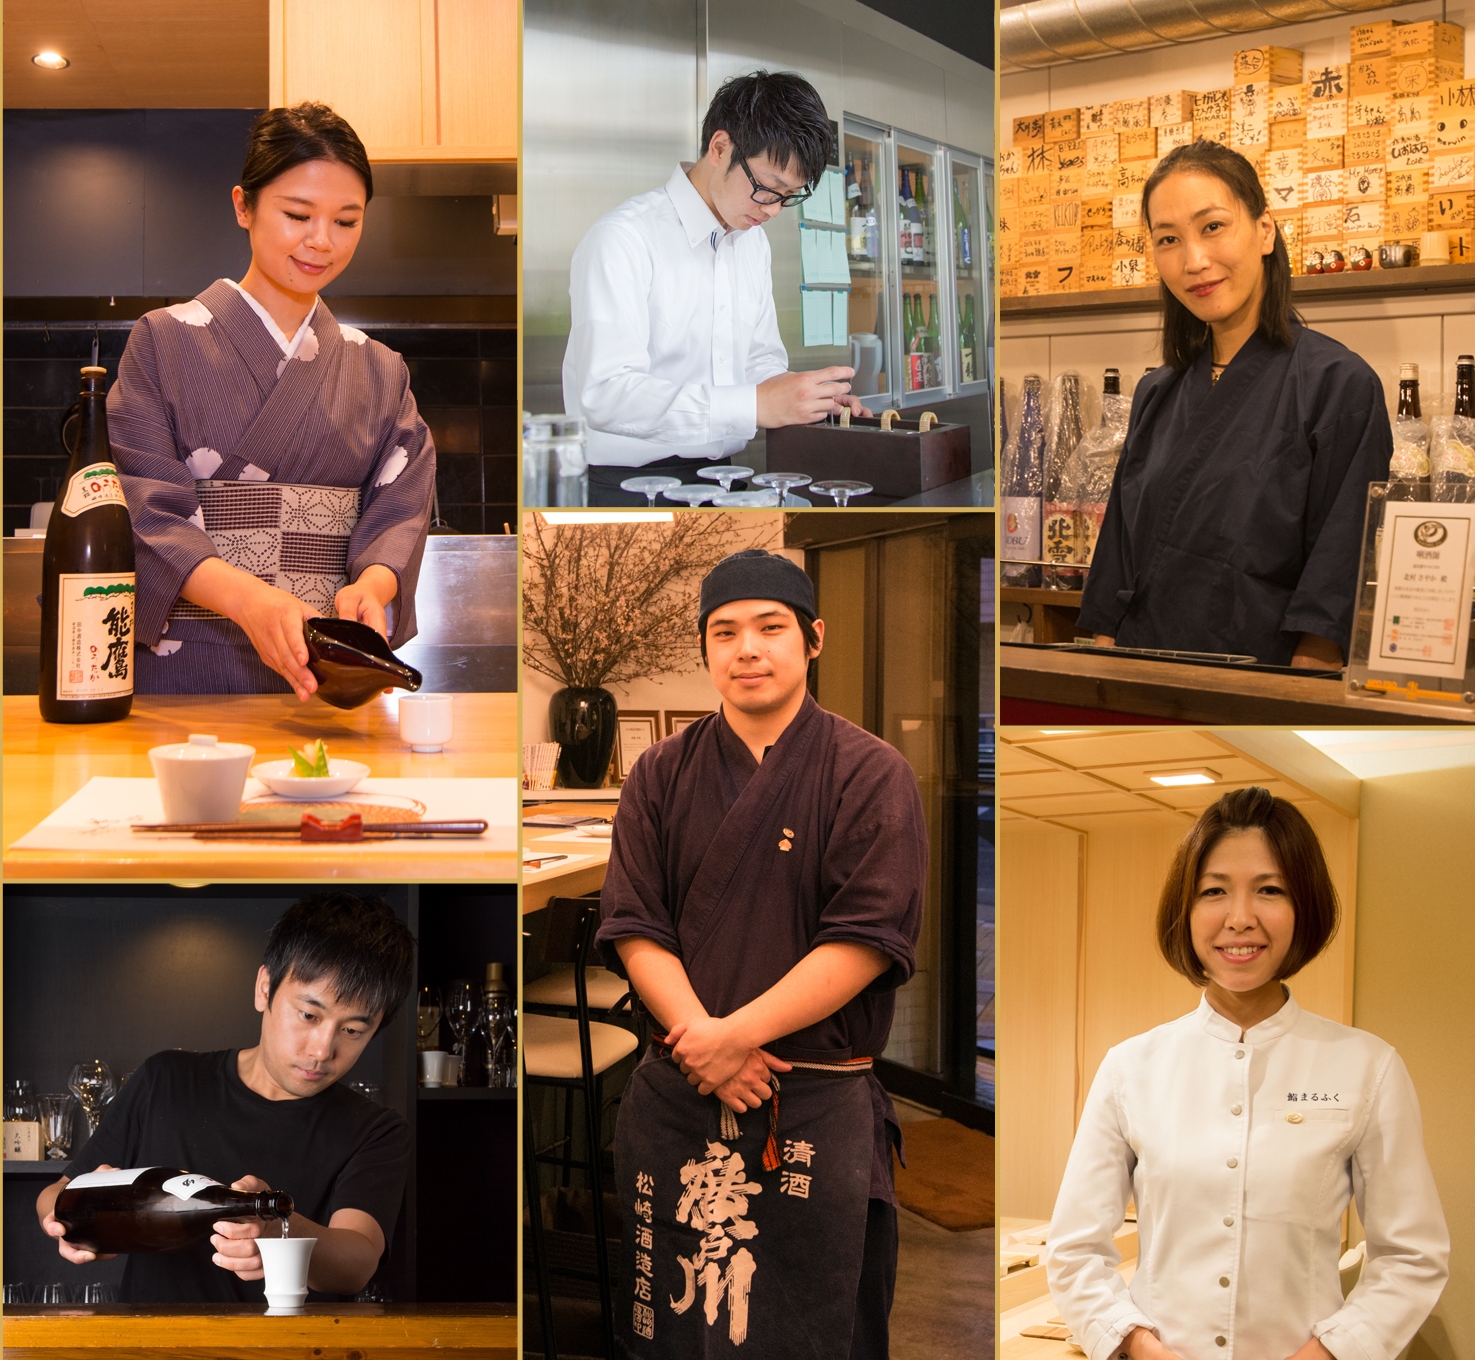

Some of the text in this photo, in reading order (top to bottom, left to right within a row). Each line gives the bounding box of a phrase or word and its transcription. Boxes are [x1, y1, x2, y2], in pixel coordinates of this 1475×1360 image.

[1311, 66, 1344, 98] 赤
[1026, 144, 1053, 174] 林
[1115, 258, 1141, 274] 小泉
[101, 606, 131, 681] 能鷹
[1286, 1092, 1340, 1103] 鮨まるふく
[779, 1139, 816, 1199] 清酒
[633, 1170, 655, 1302] 松崎酒造店
